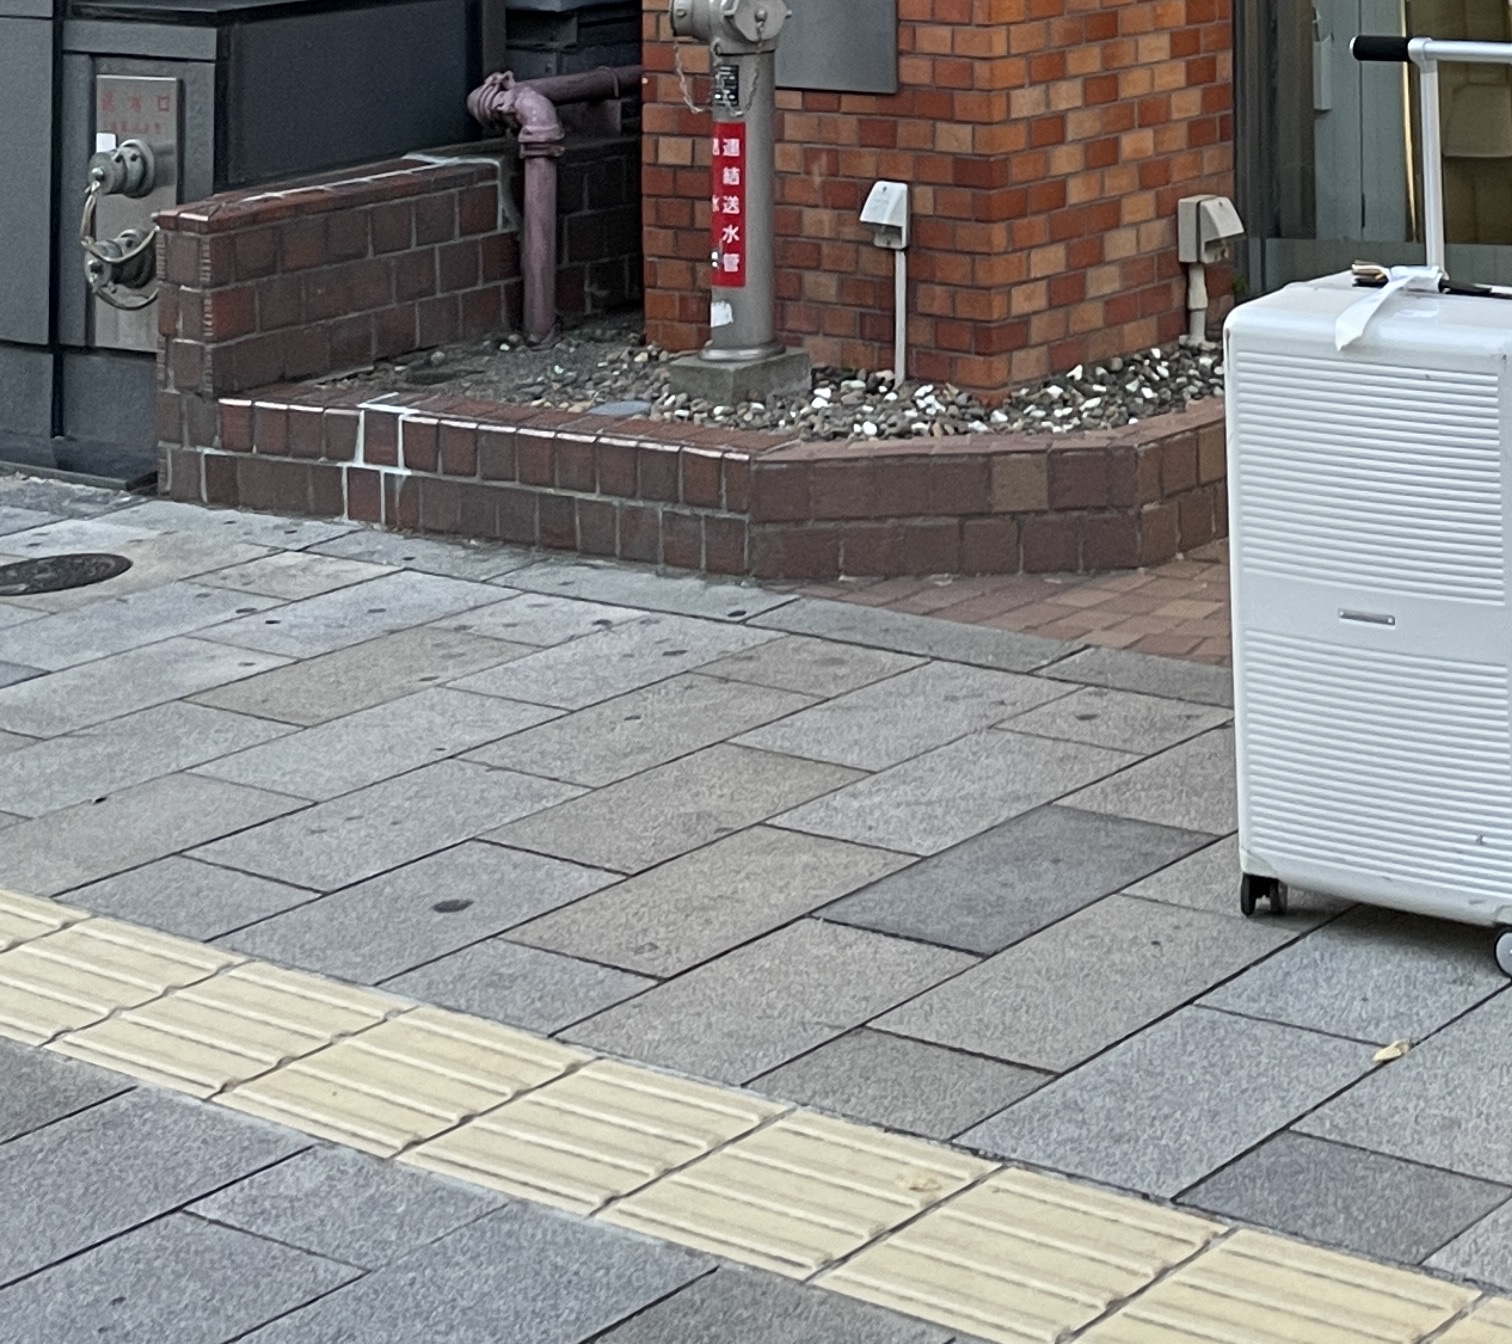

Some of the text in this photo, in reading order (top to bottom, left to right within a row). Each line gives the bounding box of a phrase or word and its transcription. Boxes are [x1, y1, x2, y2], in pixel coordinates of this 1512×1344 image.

[721, 137, 741, 274] 連結送水管
